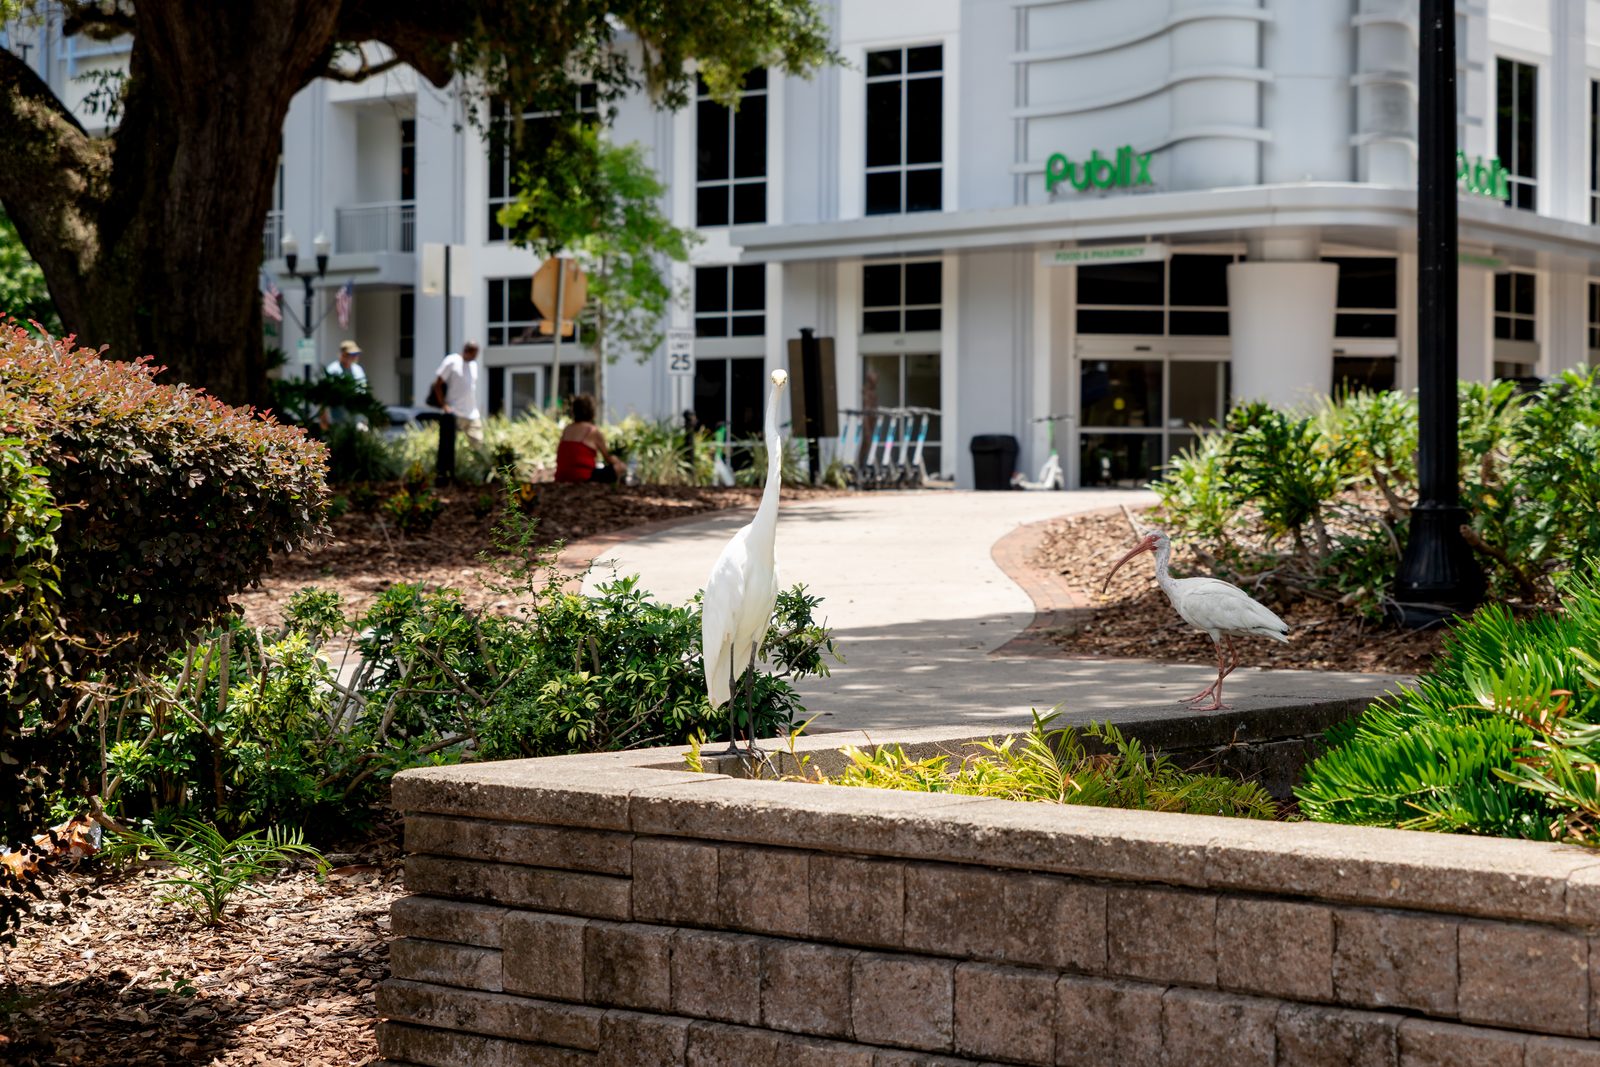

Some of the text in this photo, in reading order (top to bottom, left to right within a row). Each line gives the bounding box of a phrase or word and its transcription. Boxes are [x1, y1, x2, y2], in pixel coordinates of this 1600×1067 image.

[1046, 144, 1152, 192] Publix
[1091, 247, 1145, 259] PHARMACY
[671, 353, 691, 370] 25
